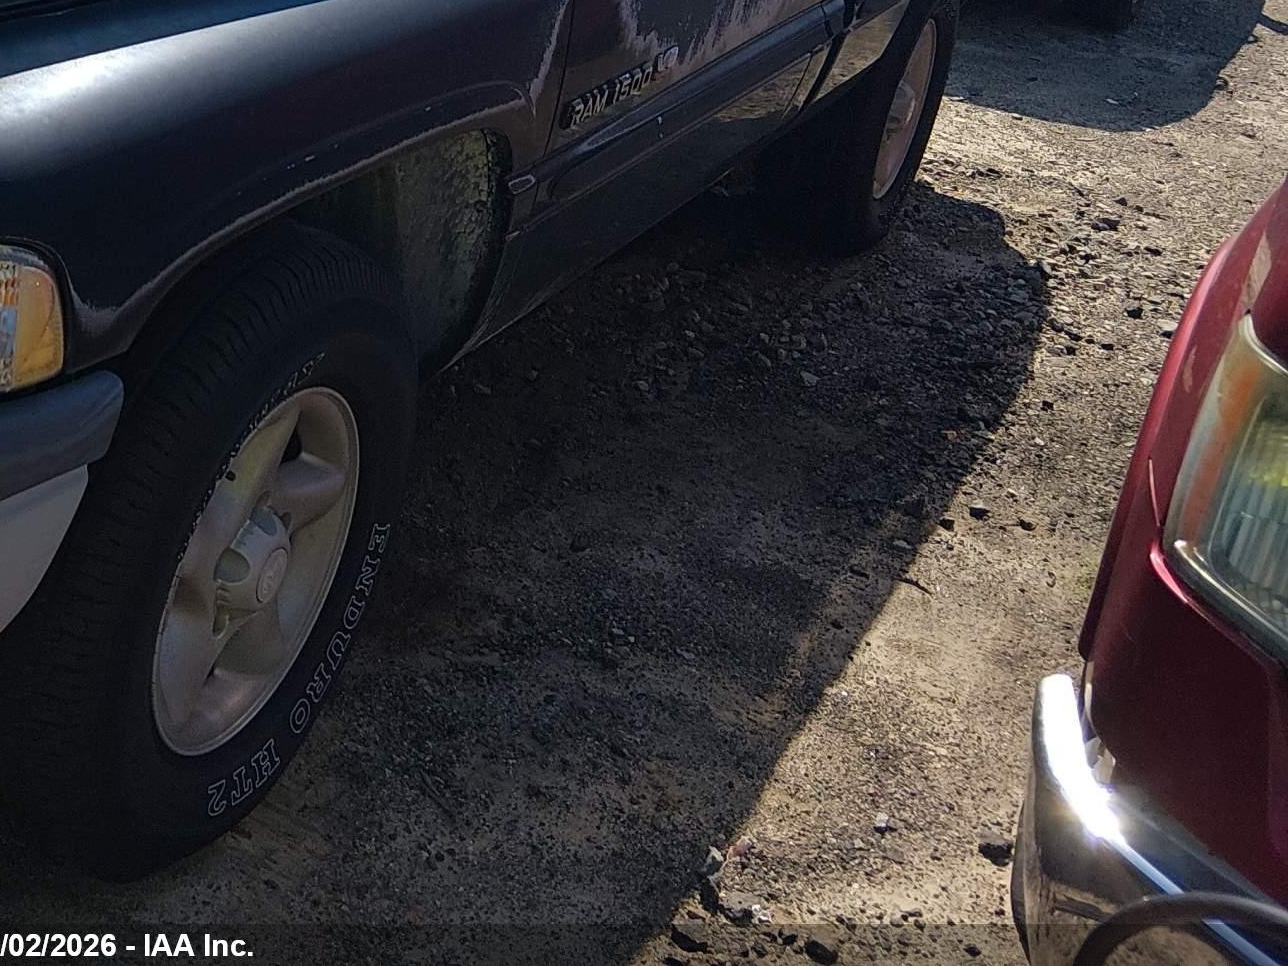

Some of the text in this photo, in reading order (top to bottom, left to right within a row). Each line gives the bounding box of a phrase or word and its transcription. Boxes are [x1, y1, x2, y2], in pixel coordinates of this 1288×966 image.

[569, 61, 654, 130] RAM 1500
[207, 523, 391, 817] ENDURO HT2
